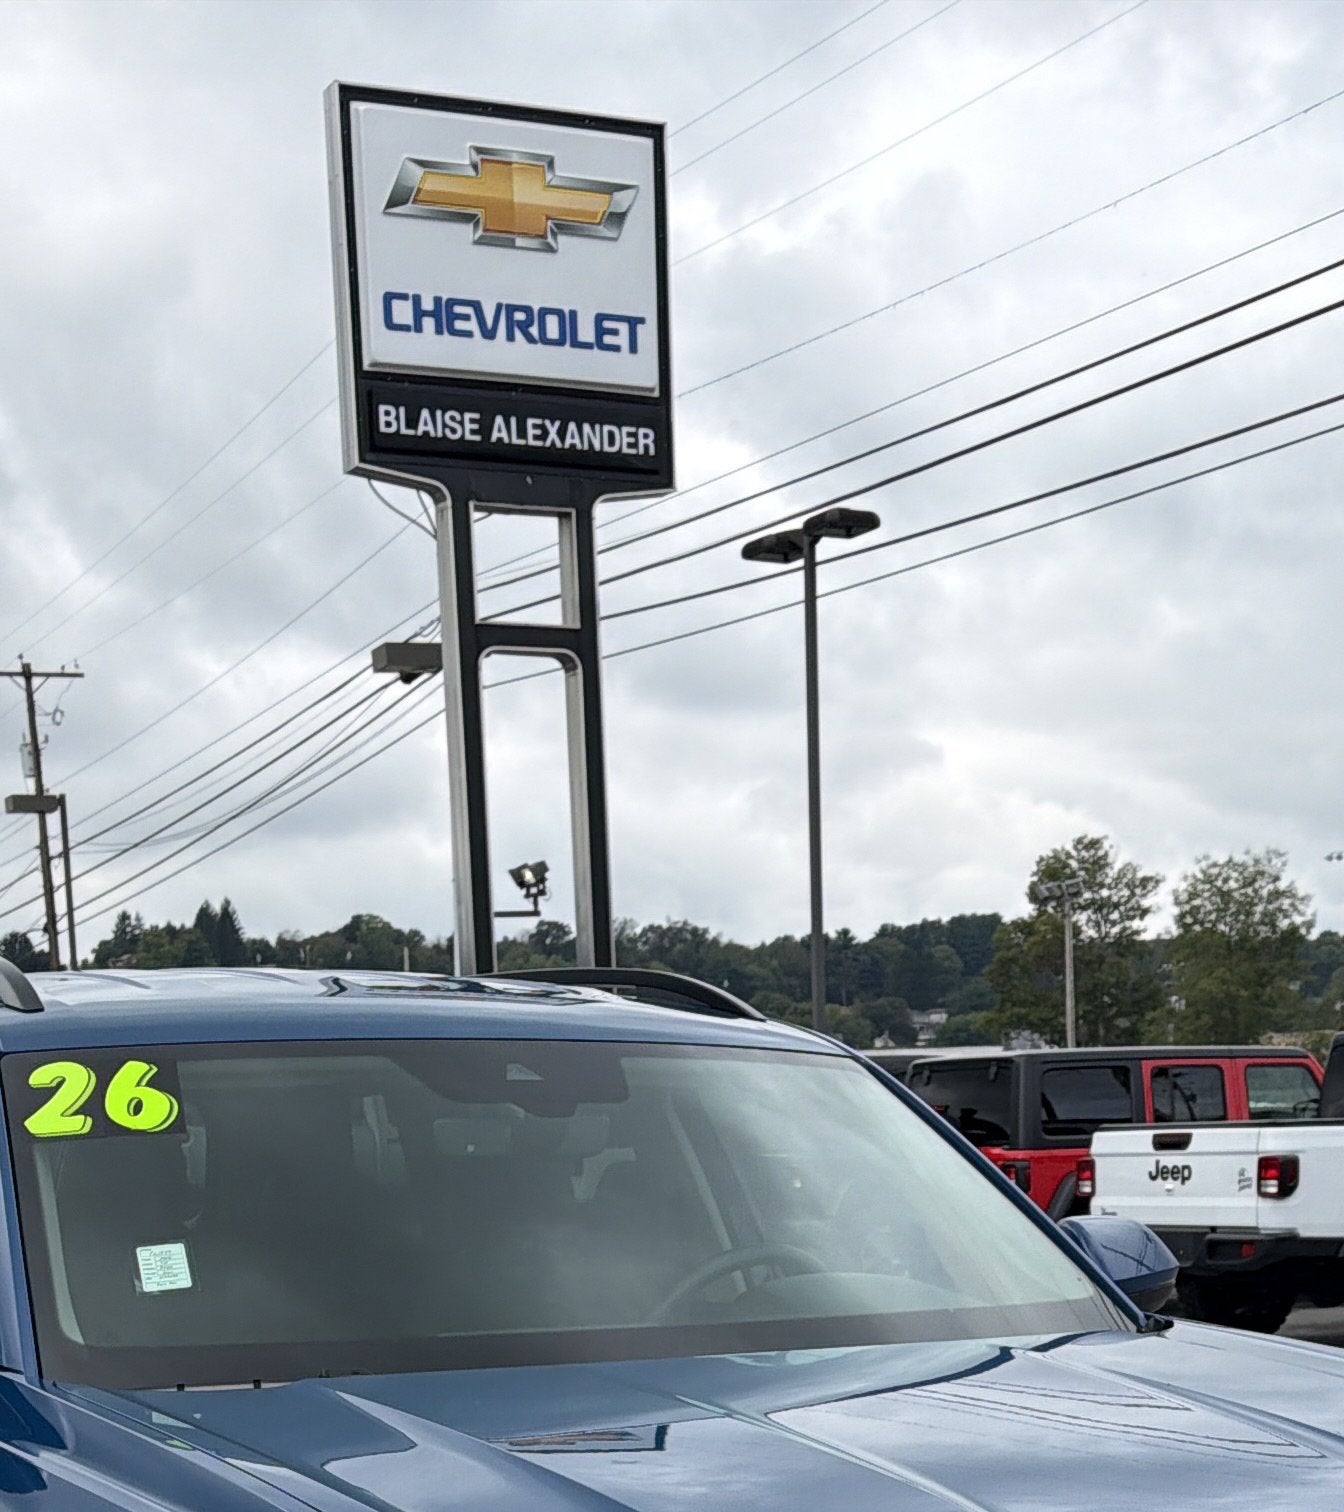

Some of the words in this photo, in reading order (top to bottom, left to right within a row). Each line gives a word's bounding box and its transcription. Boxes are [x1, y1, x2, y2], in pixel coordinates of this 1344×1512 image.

[382, 290, 646, 355] CHEVROLET
[377, 403, 483, 442] BLAISE
[489, 414, 656, 457] ALEXANDER
[23, 1060, 180, 1139] 26
[1147, 1158, 1193, 1186] Jeep
